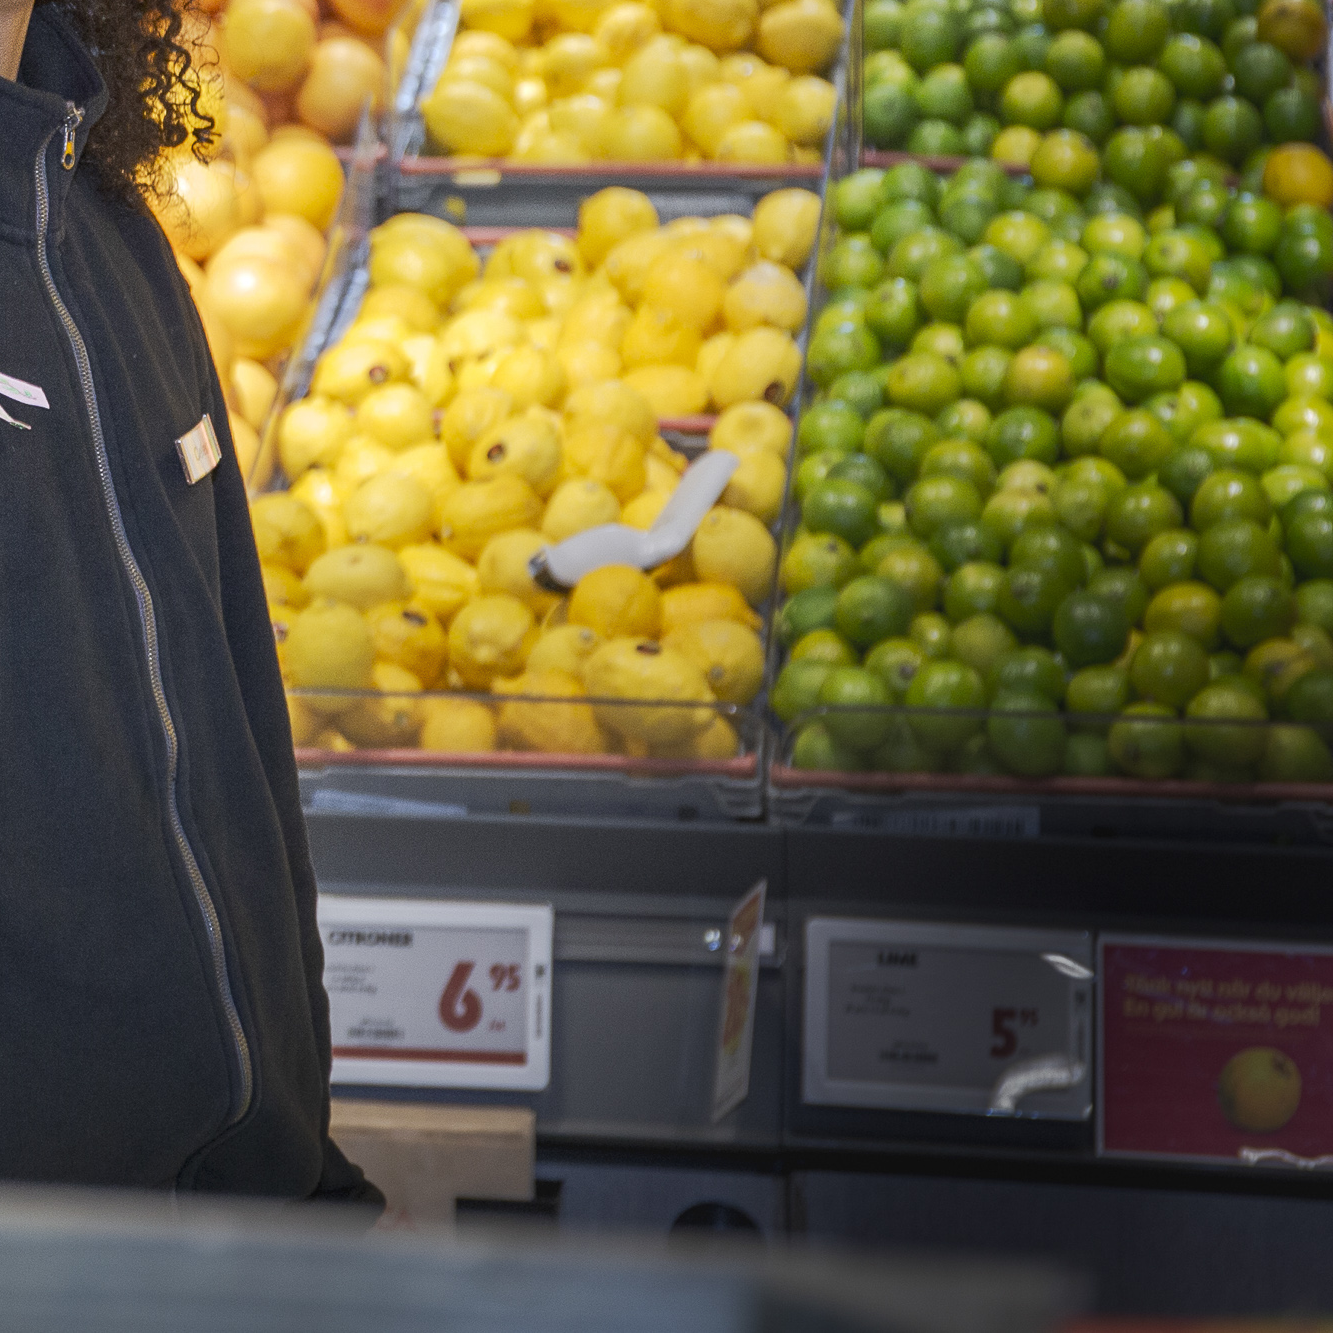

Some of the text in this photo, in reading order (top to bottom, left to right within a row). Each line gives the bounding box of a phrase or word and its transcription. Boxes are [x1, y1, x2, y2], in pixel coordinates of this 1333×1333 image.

[438, 961, 483, 1033] 6
[489, 963, 521, 992] 95
[989, 1007, 1019, 1059] 5
